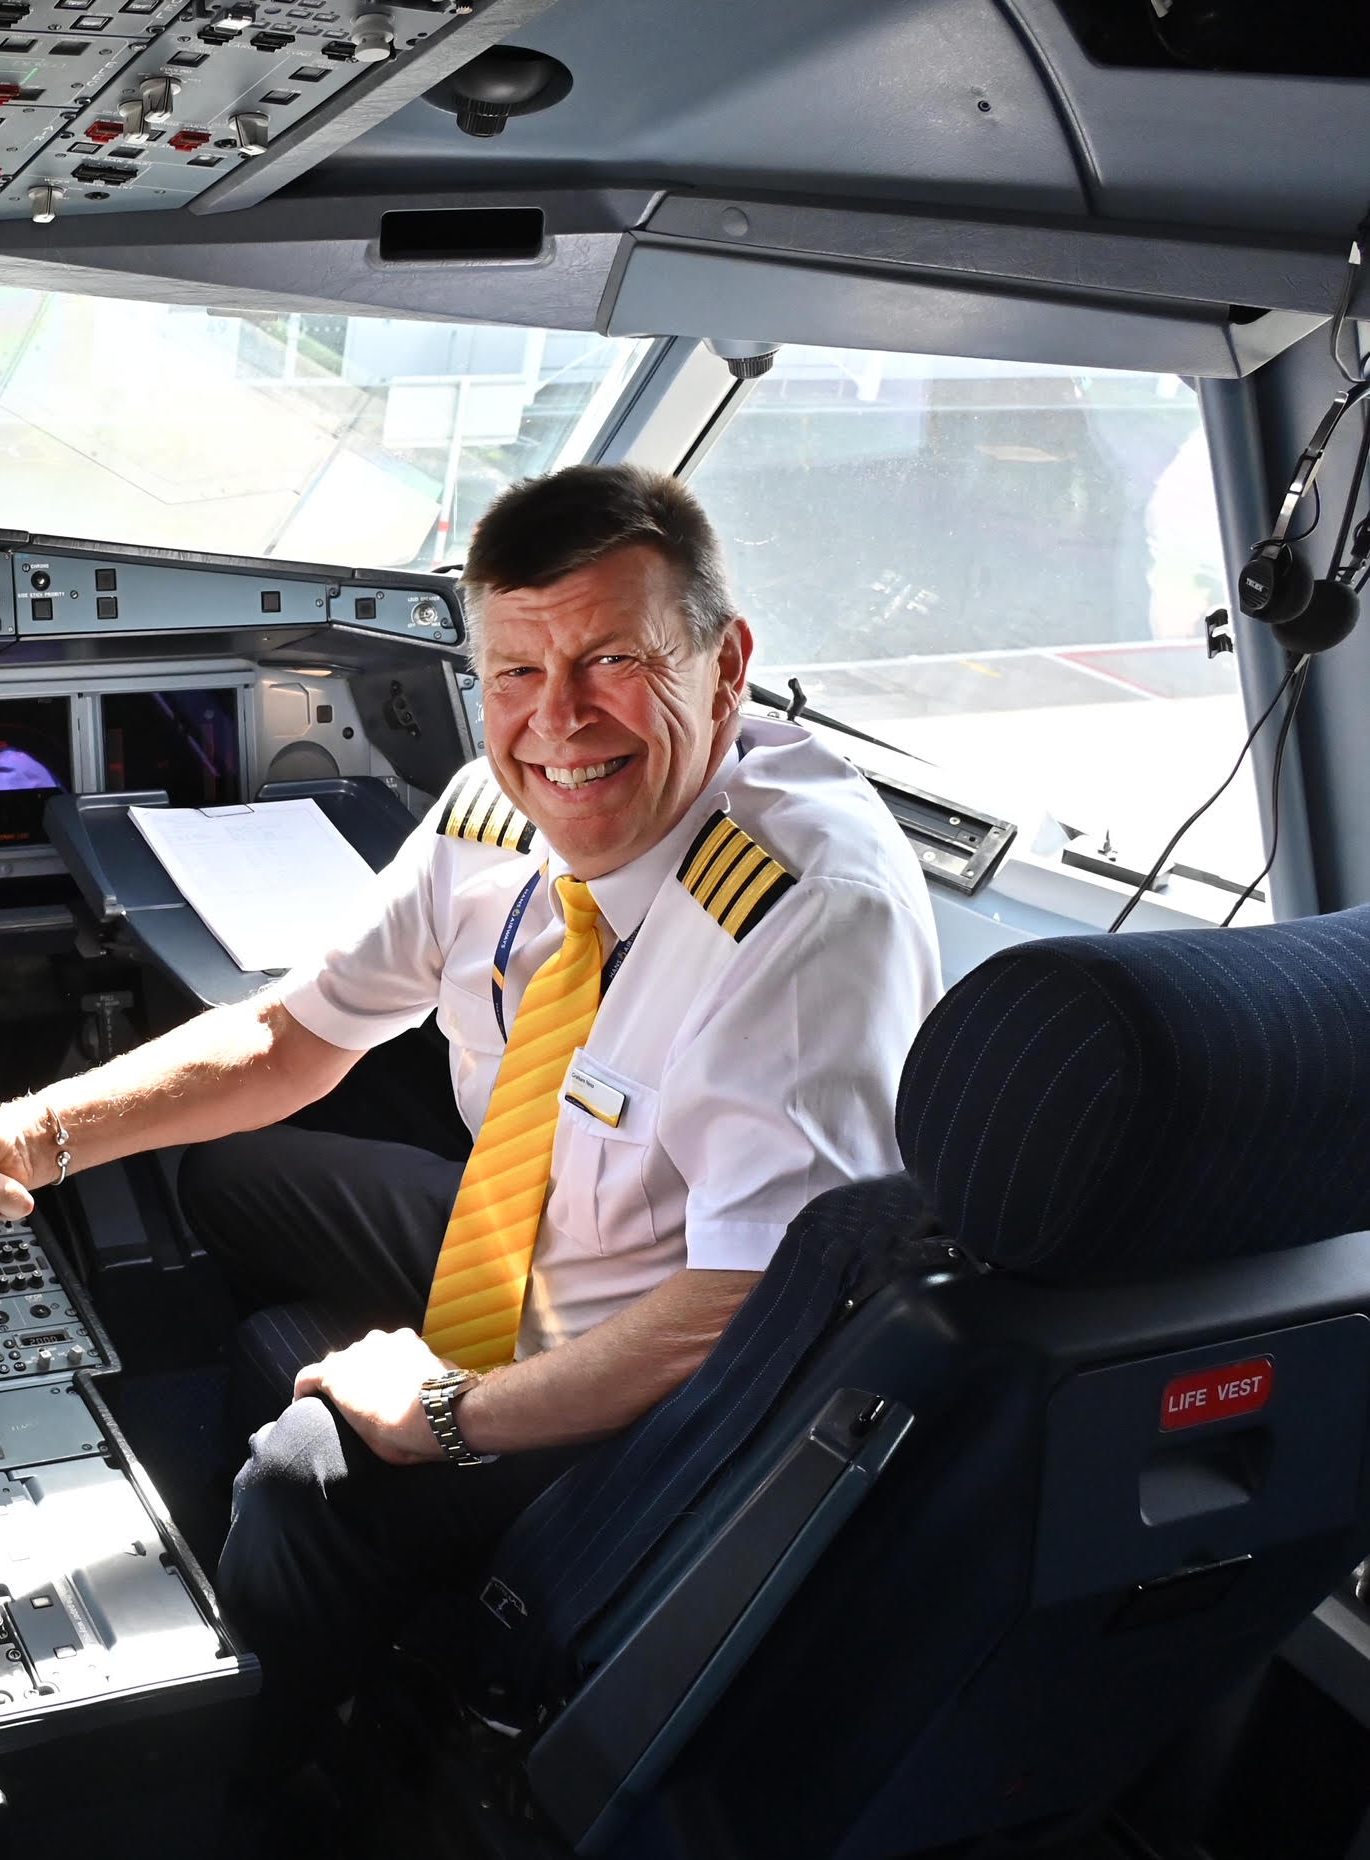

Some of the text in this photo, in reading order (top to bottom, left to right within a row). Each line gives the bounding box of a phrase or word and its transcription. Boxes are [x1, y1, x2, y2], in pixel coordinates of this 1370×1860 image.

[501, 889, 529, 949] HANS AIRWAYS
[609, 960, 621, 979] HANS
[1168, 1376, 1262, 1413] LIFE VEST
[66, 1603, 82, 1622] paper
[77, 1620, 88, 1634] way
